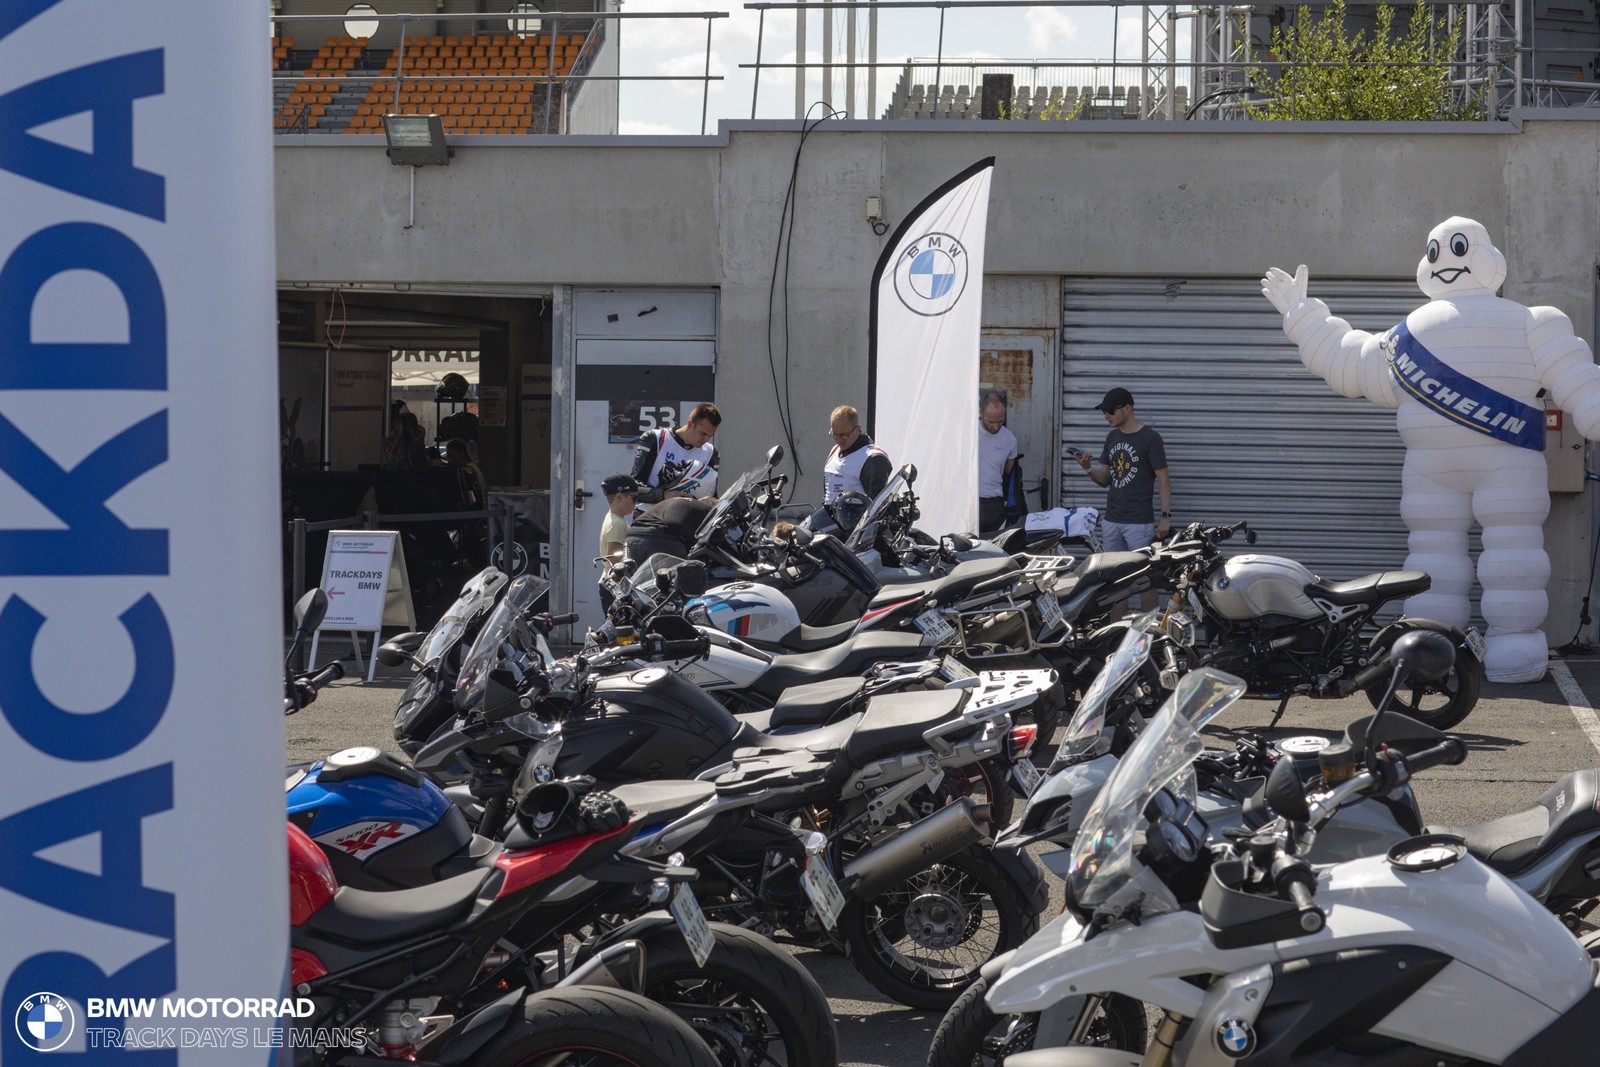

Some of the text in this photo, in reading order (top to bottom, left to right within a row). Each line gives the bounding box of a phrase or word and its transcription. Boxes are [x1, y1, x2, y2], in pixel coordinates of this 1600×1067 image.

[907, 236, 961, 259] BMW
[1397, 352, 1527, 435] MICHELIN
[638, 406, 676, 431] 53
[0, 0, 178, 1067] RACKDA
[330, 570, 383, 579] TRACKDAYS
[358, 582, 381, 590] BMW
[336, 823, 379, 843] S1000
[337, 822, 405, 857] XR
